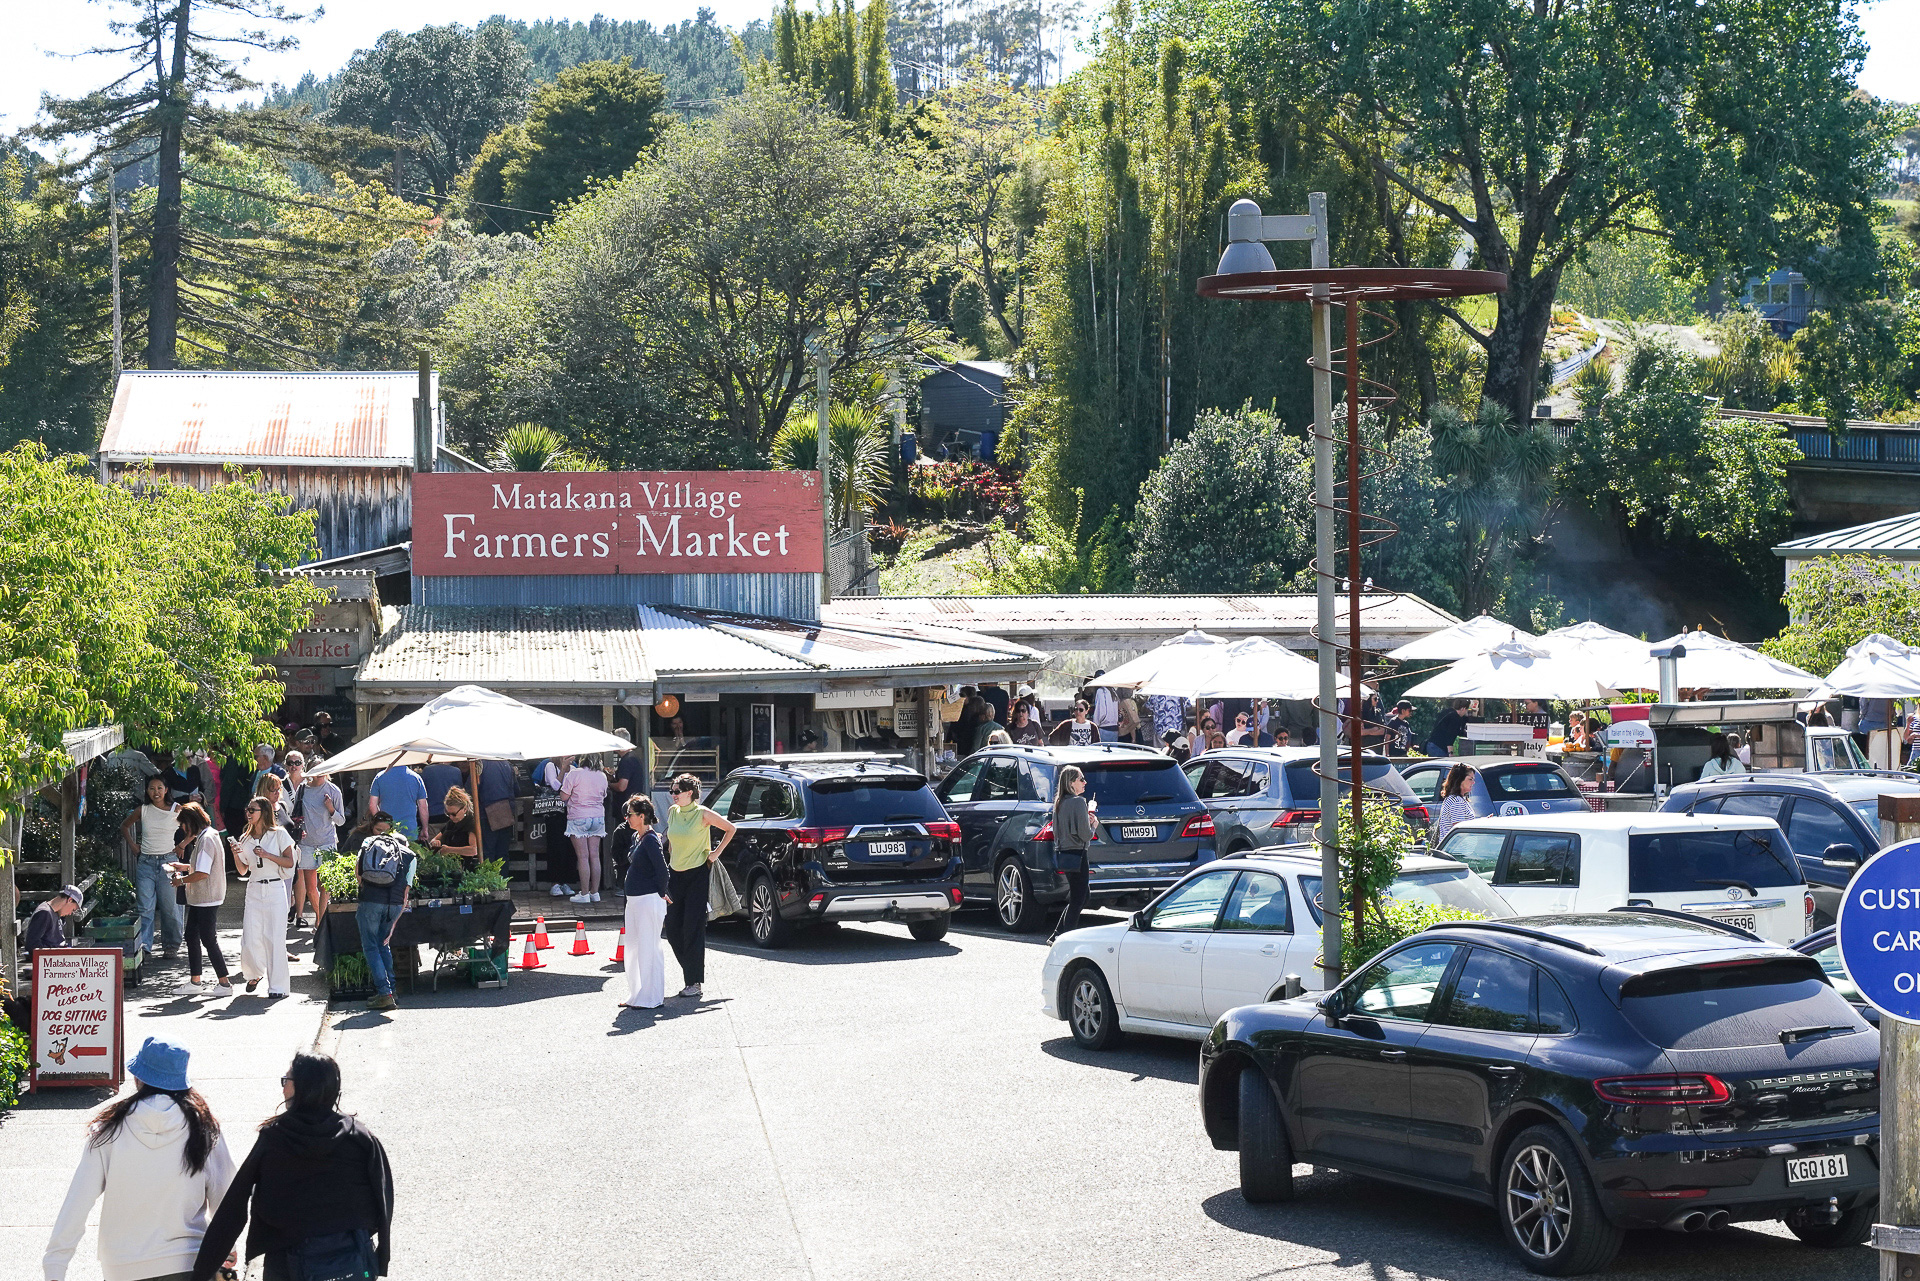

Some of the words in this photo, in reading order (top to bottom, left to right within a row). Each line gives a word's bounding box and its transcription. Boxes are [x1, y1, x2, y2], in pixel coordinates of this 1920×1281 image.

[492, 483, 632, 510] Matakana
[639, 481, 742, 518] Village
[443, 513, 619, 558] Farmers'
[636, 513, 790, 558] Market
[283, 638, 350, 657] Market
[289, 684, 315, 694] Food
[1498, 715, 1547, 723] ITLIAN
[1523, 742, 1543, 752] Italy
[1123, 826, 1155, 838] HMM991
[870, 843, 905, 854] LUJ983
[43, 958, 80, 968] Matakana
[80, 957, 109, 971] Village
[43, 968, 78, 979] Farmers'
[79, 967, 109, 978] Market
[46, 982, 88, 1000] Please
[57, 995, 78, 1007] use
[79, 988, 106, 1003] our
[41, 1009, 62, 1021] DOG
[63, 1009, 107, 1022] SITTING
[47, 1023, 100, 1036] SERVICE
[1762, 1070, 1854, 1086] PORSCHE
[1792, 1085, 1821, 1094] Macan
[1821, 1082, 1831, 1092] S
[1789, 1157, 1845, 1181] KGQ181
